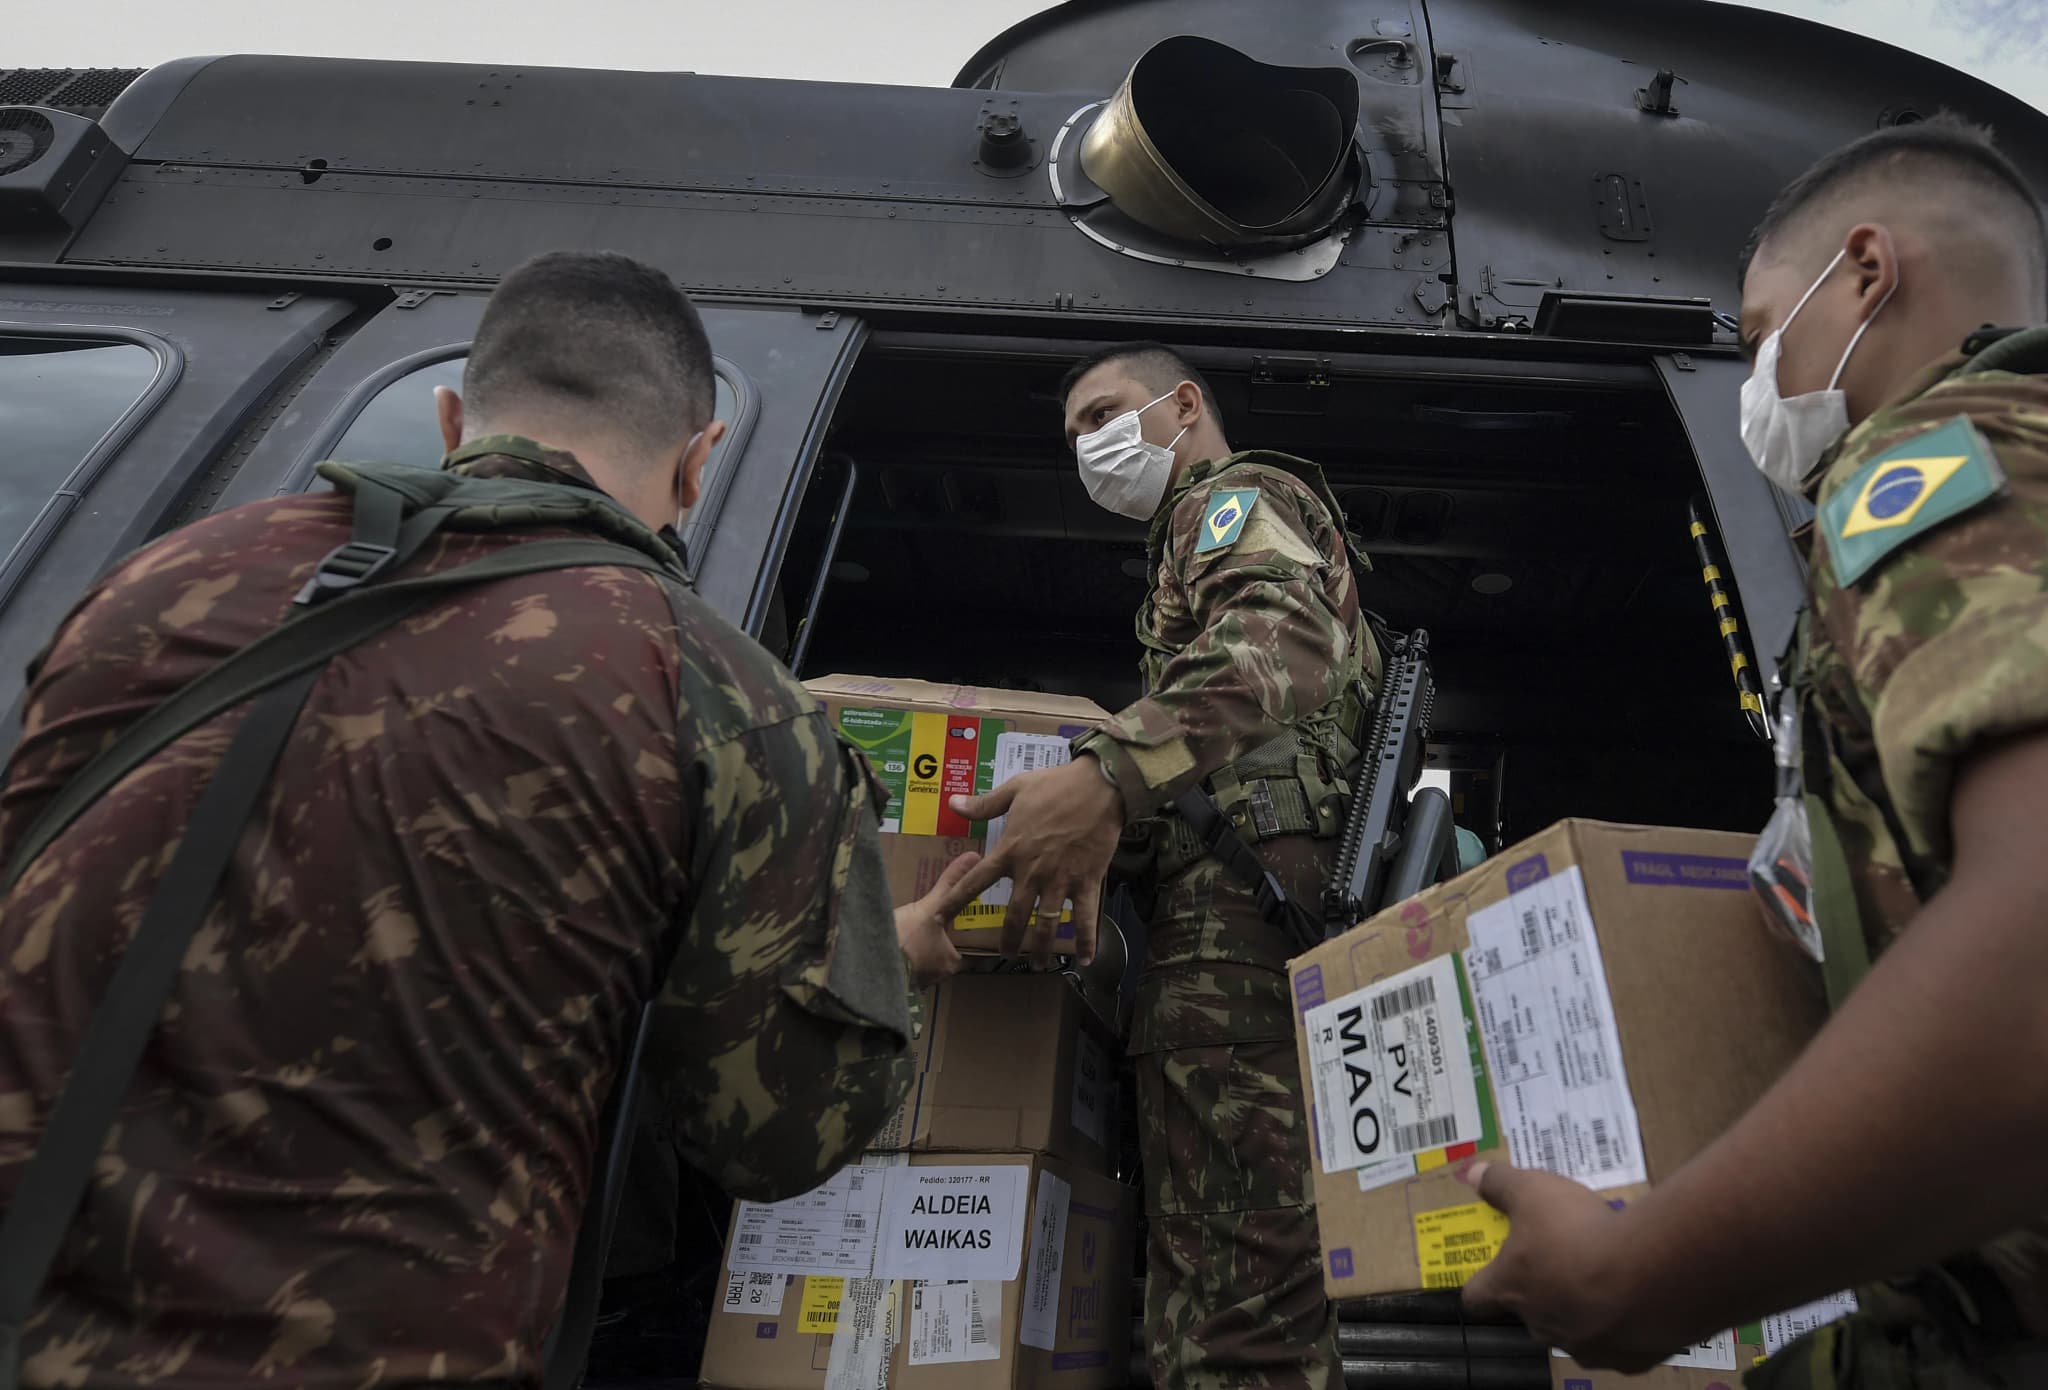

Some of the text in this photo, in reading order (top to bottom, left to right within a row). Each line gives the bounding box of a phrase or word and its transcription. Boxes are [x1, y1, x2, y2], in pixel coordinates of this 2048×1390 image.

[914, 754, 938, 779] G
[908, 784, 939, 793] Genérico
[1322, 1028, 1334, 1044] R
[1337, 1005, 1381, 1155] MAO
[1387, 1043, 1412, 1098] PV
[919, 1176, 947, 1184] Pedido:
[948, 1176, 973, 1184] 320177
[979, 1175, 990, 1184] RR
[911, 1194, 991, 1215] ALDEIA
[905, 1229, 991, 1249] WAIKAS
[726, 1271, 746, 1305] LTRAO
[750, 1288, 763, 1304] 20
